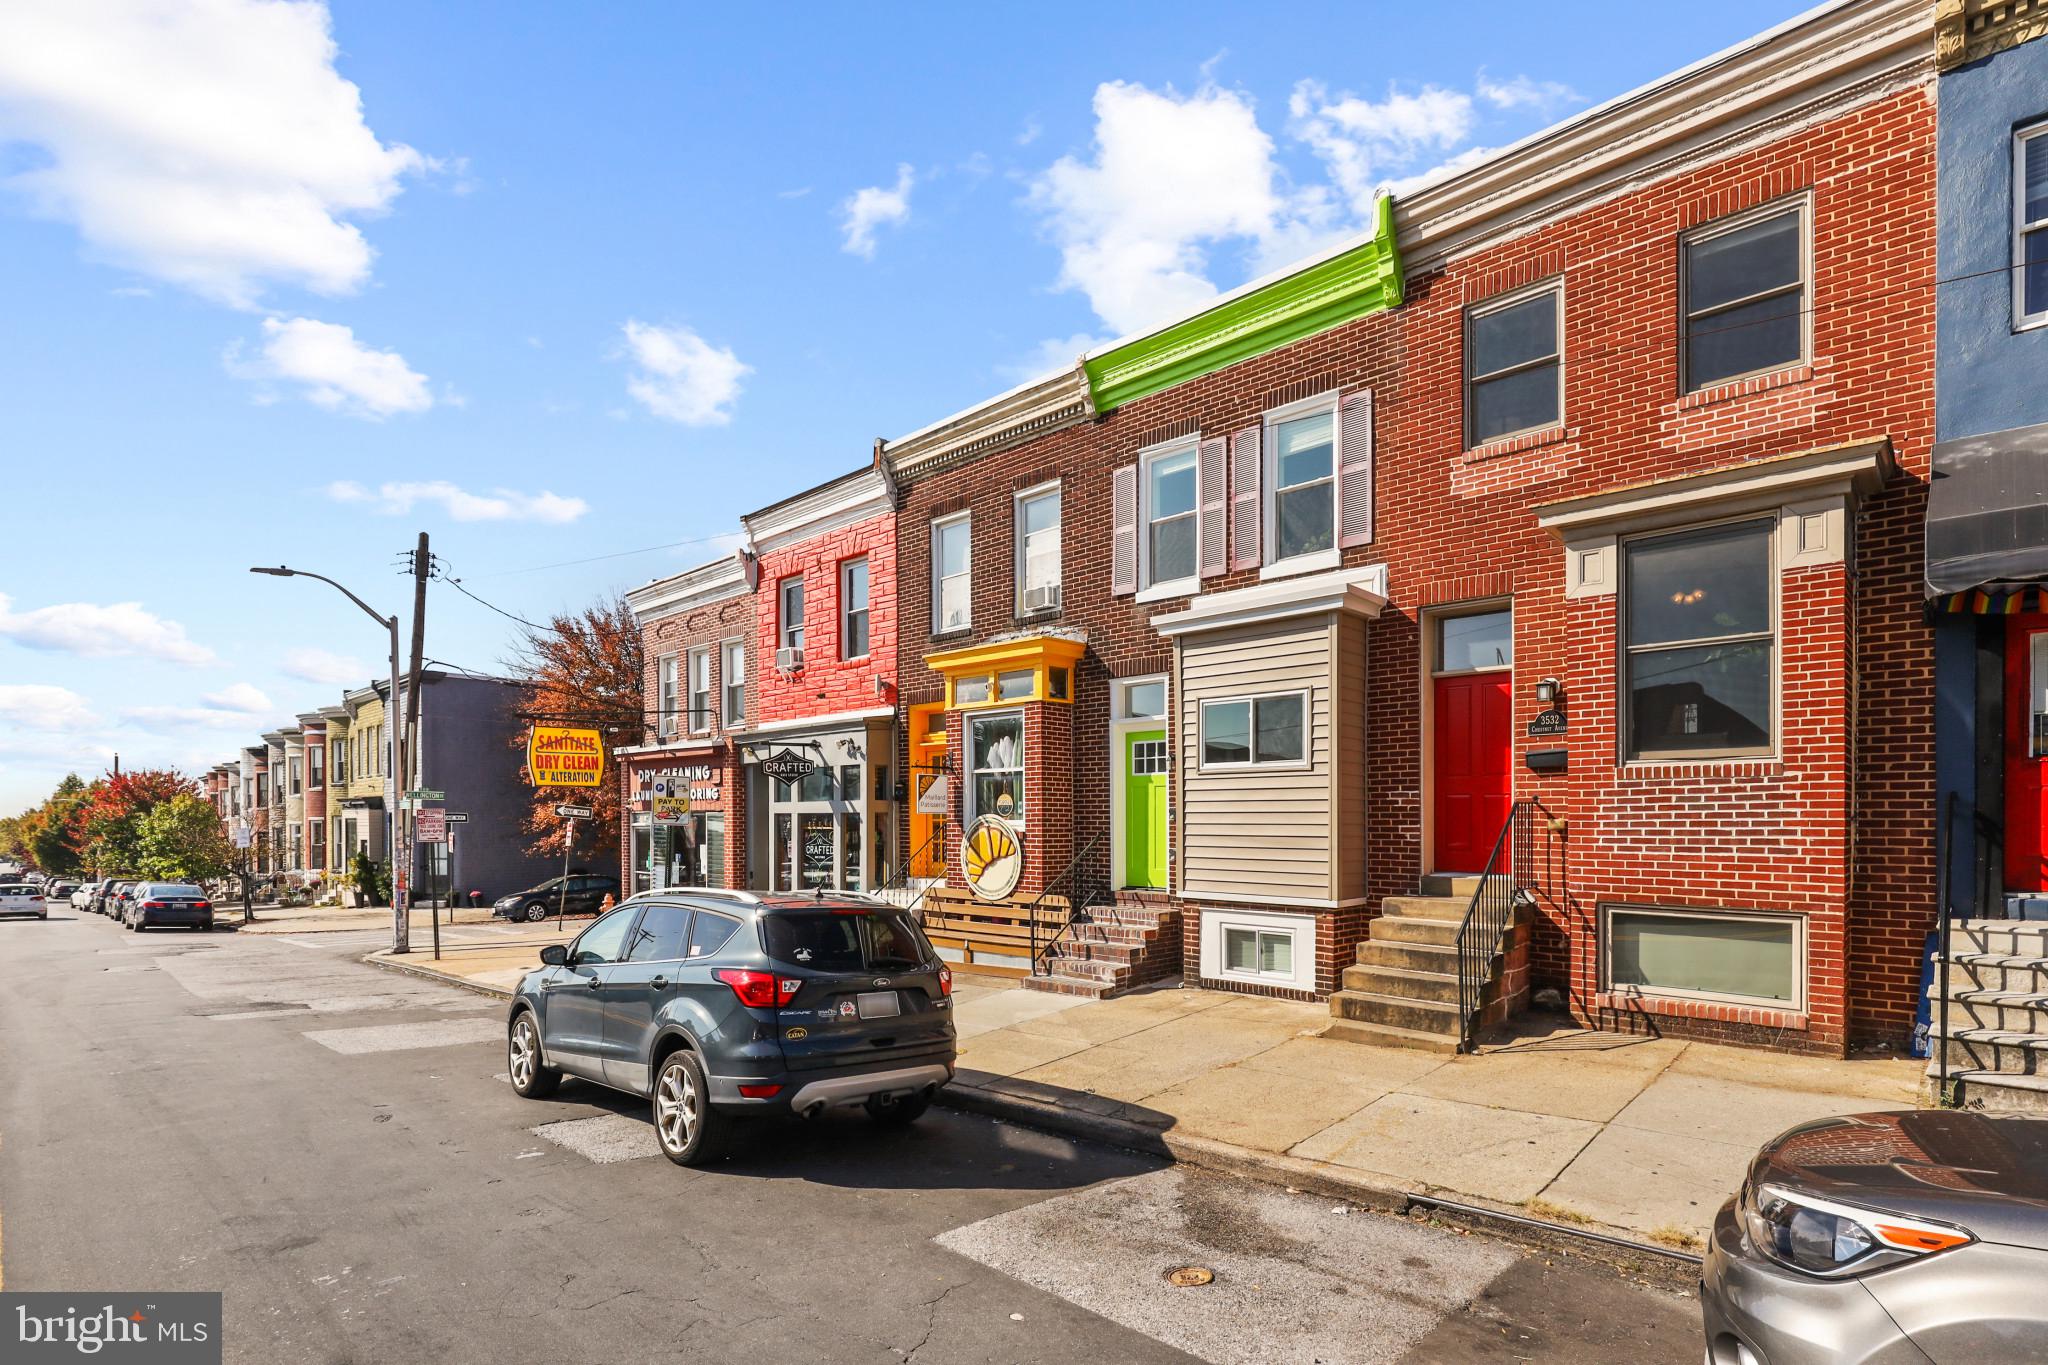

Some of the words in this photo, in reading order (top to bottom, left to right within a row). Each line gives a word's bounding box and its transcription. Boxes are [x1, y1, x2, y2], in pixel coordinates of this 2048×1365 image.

[1540, 714, 1560, 724] 3532
[535, 754, 560, 770] DRY
[562, 755, 599, 770] CLEAN
[765, 762, 812, 773] CRAFTED
[550, 771, 595, 783] ALTERATION
[638, 768, 657, 783] DRY
[661, 765, 711, 781] CLEANING
[805, 845, 834, 855] CRAFTED
